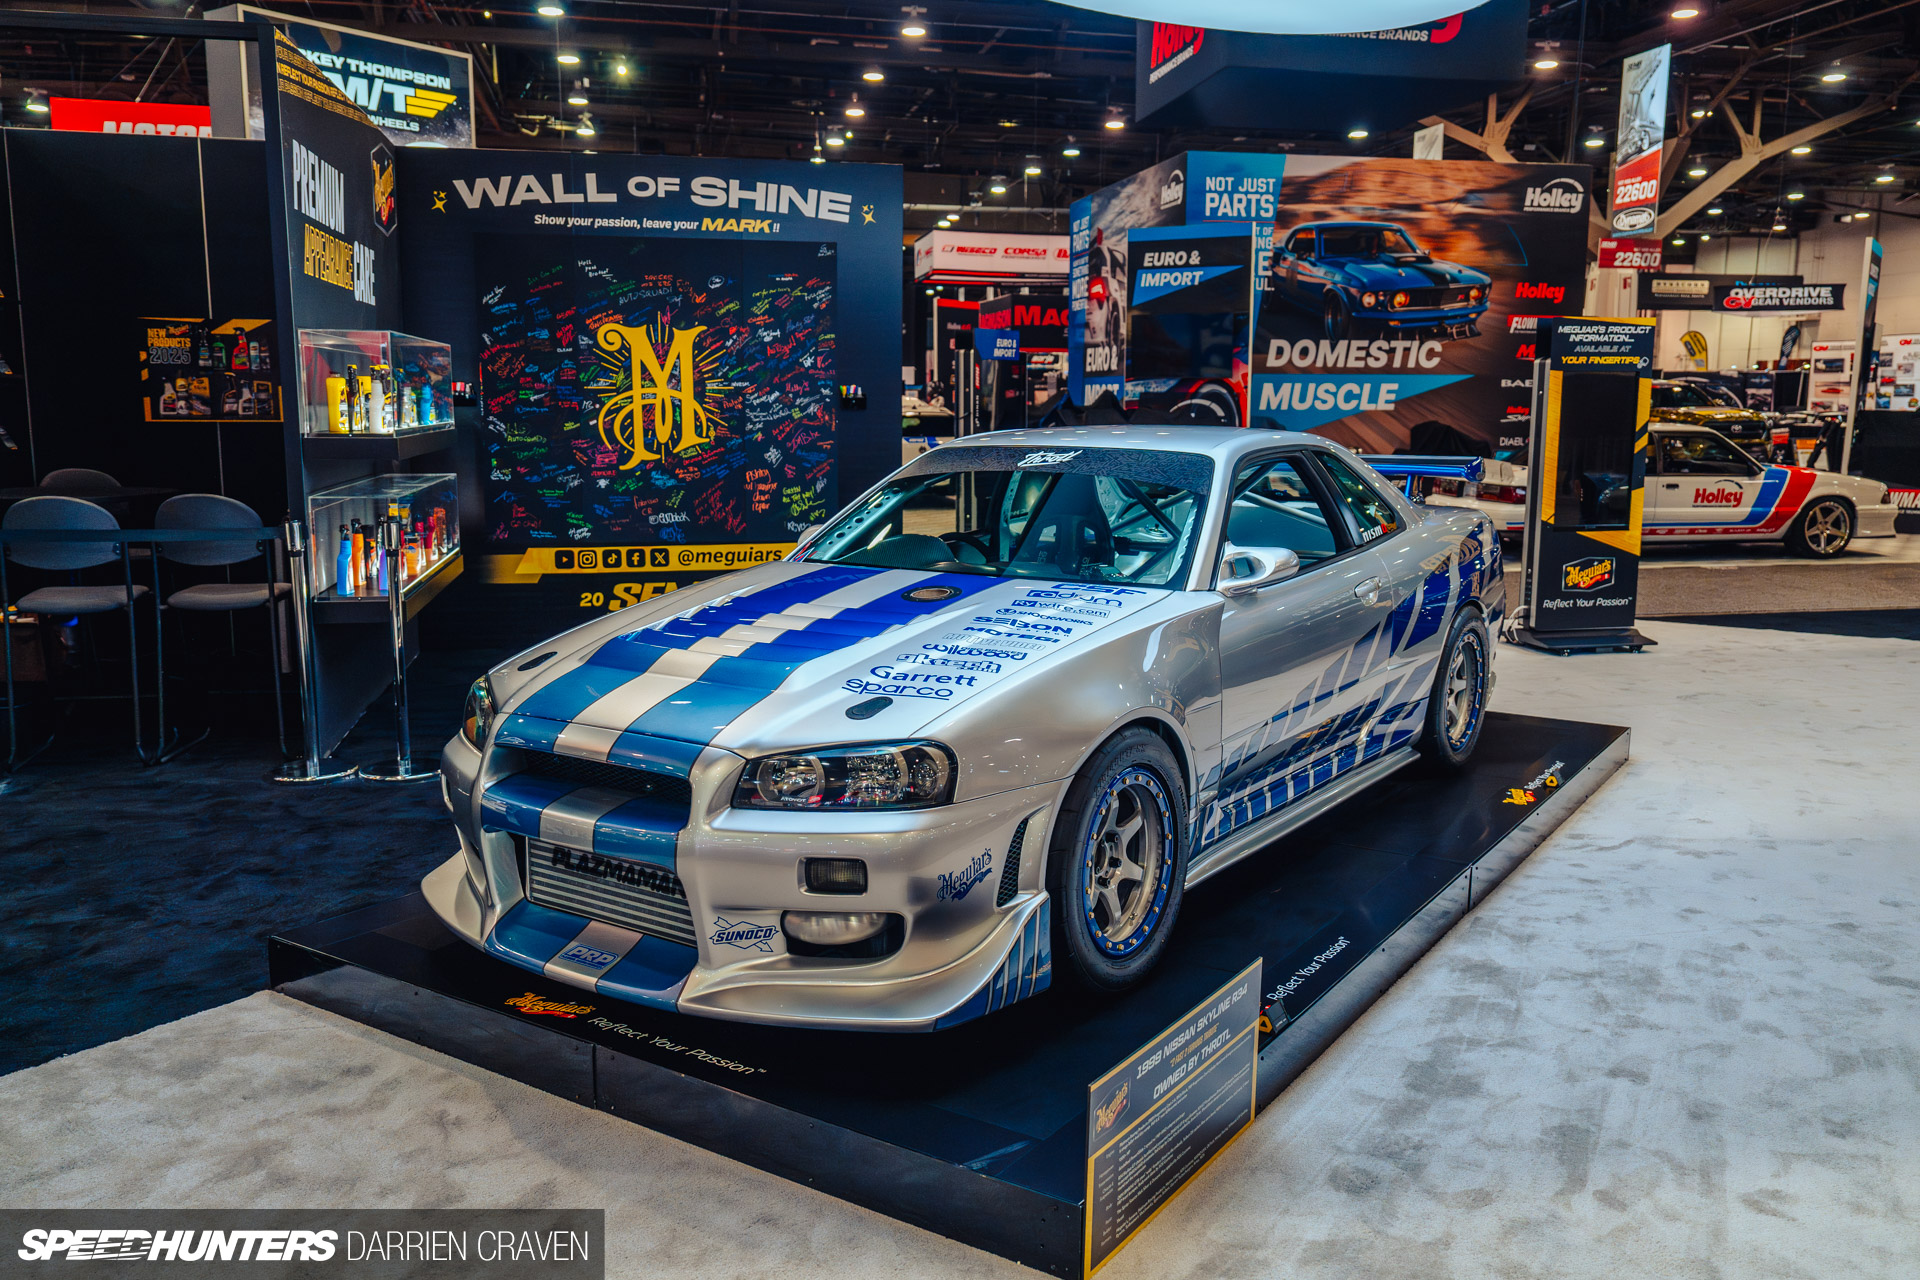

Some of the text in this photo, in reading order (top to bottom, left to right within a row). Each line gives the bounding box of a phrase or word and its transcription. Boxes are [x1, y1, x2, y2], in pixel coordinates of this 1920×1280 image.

[1378, 29, 1429, 42] BRANDS
[299, 49, 346, 70] KEY
[346, 57, 451, 90] THOMPSON
[368, 114, 420, 132] WHEELS
[292, 139, 345, 235] PREMIUM
[1205, 176, 1276, 193] NOT JUST
[1615, 179, 1657, 204] 22600
[452, 172, 852, 223] WALL OF SHINE
[1205, 193, 1274, 218] PARTS
[1524, 187, 1584, 214] Holley
[534, 213, 567, 227] Show
[569, 217, 593, 231] your
[594, 217, 641, 231] passion,
[643, 218, 671, 230] leave
[673, 220, 699, 233] your
[701, 217, 771, 234] MARK
[1262, 226, 1274, 236] OF
[304, 223, 354, 291] APPEARANCE
[1004, 246, 1047, 256] CORSA
[1143, 250, 1201, 267] EURO &
[1613, 251, 1661, 267] 22600
[353, 240, 376, 306] CARE
[1140, 271, 1203, 288] IMPORT
[1254, 277, 1275, 291] UL.
[1515, 282, 1565, 304] Holley
[1730, 286, 1832, 299] OVERDRIVE
[1752, 297, 1780, 306] GEAR
[1782, 296, 1834, 306] VENDORS
[147, 328, 166, 338] NEW
[1558, 325, 1652, 334] MEGUIAR'S PRODUCT
[147, 337, 191, 347] PRODUCTS
[996, 338, 1012, 348] EURO
[1574, 345, 1632, 353] AVAILABLE AT
[149, 347, 192, 364] 2025
[993, 349, 1016, 358] IMPORT
[1085, 345, 1118, 372] EURO &
[1265, 338, 1443, 369] DOMESTIC
[1561, 356, 1641, 364] YOUR FINGERTIPS
[1501, 378, 1533, 387] BAE
[1258, 382, 1400, 411] MUSCLE
[1693, 488, 1743, 508] Holley
[1362, 523, 1387, 542] nismo
[678, 547, 782, 566] @meguiars
[1051, 583, 1147, 596] CSF
[580, 592, 604, 607] 20
[1543, 599, 1573, 610] Reflect
[1576, 598, 1594, 607] Your
[963, 626, 1061, 643] MOTEGI
[922, 643, 1028, 661] wilwood
[870, 665, 978, 687] Garrett
[845, 678, 954, 696] sparco
[552, 847, 687, 899] PLAZMAMAN
[937, 848, 992, 902] Meguiar's
[715, 928, 773, 942] SUNOCO
[567, 947, 615, 967] PRP
[1266, 976, 1305, 1000] Reflect
[1295, 961, 1322, 976] Your
[588, 1016, 648, 1039] Reflect
[649, 1035, 688, 1052] Your
[1136, 983, 1248, 1079] 1999 NISSAN SKYLINE R34
[1153, 1028, 1232, 1099] OWNED BY THROTL
